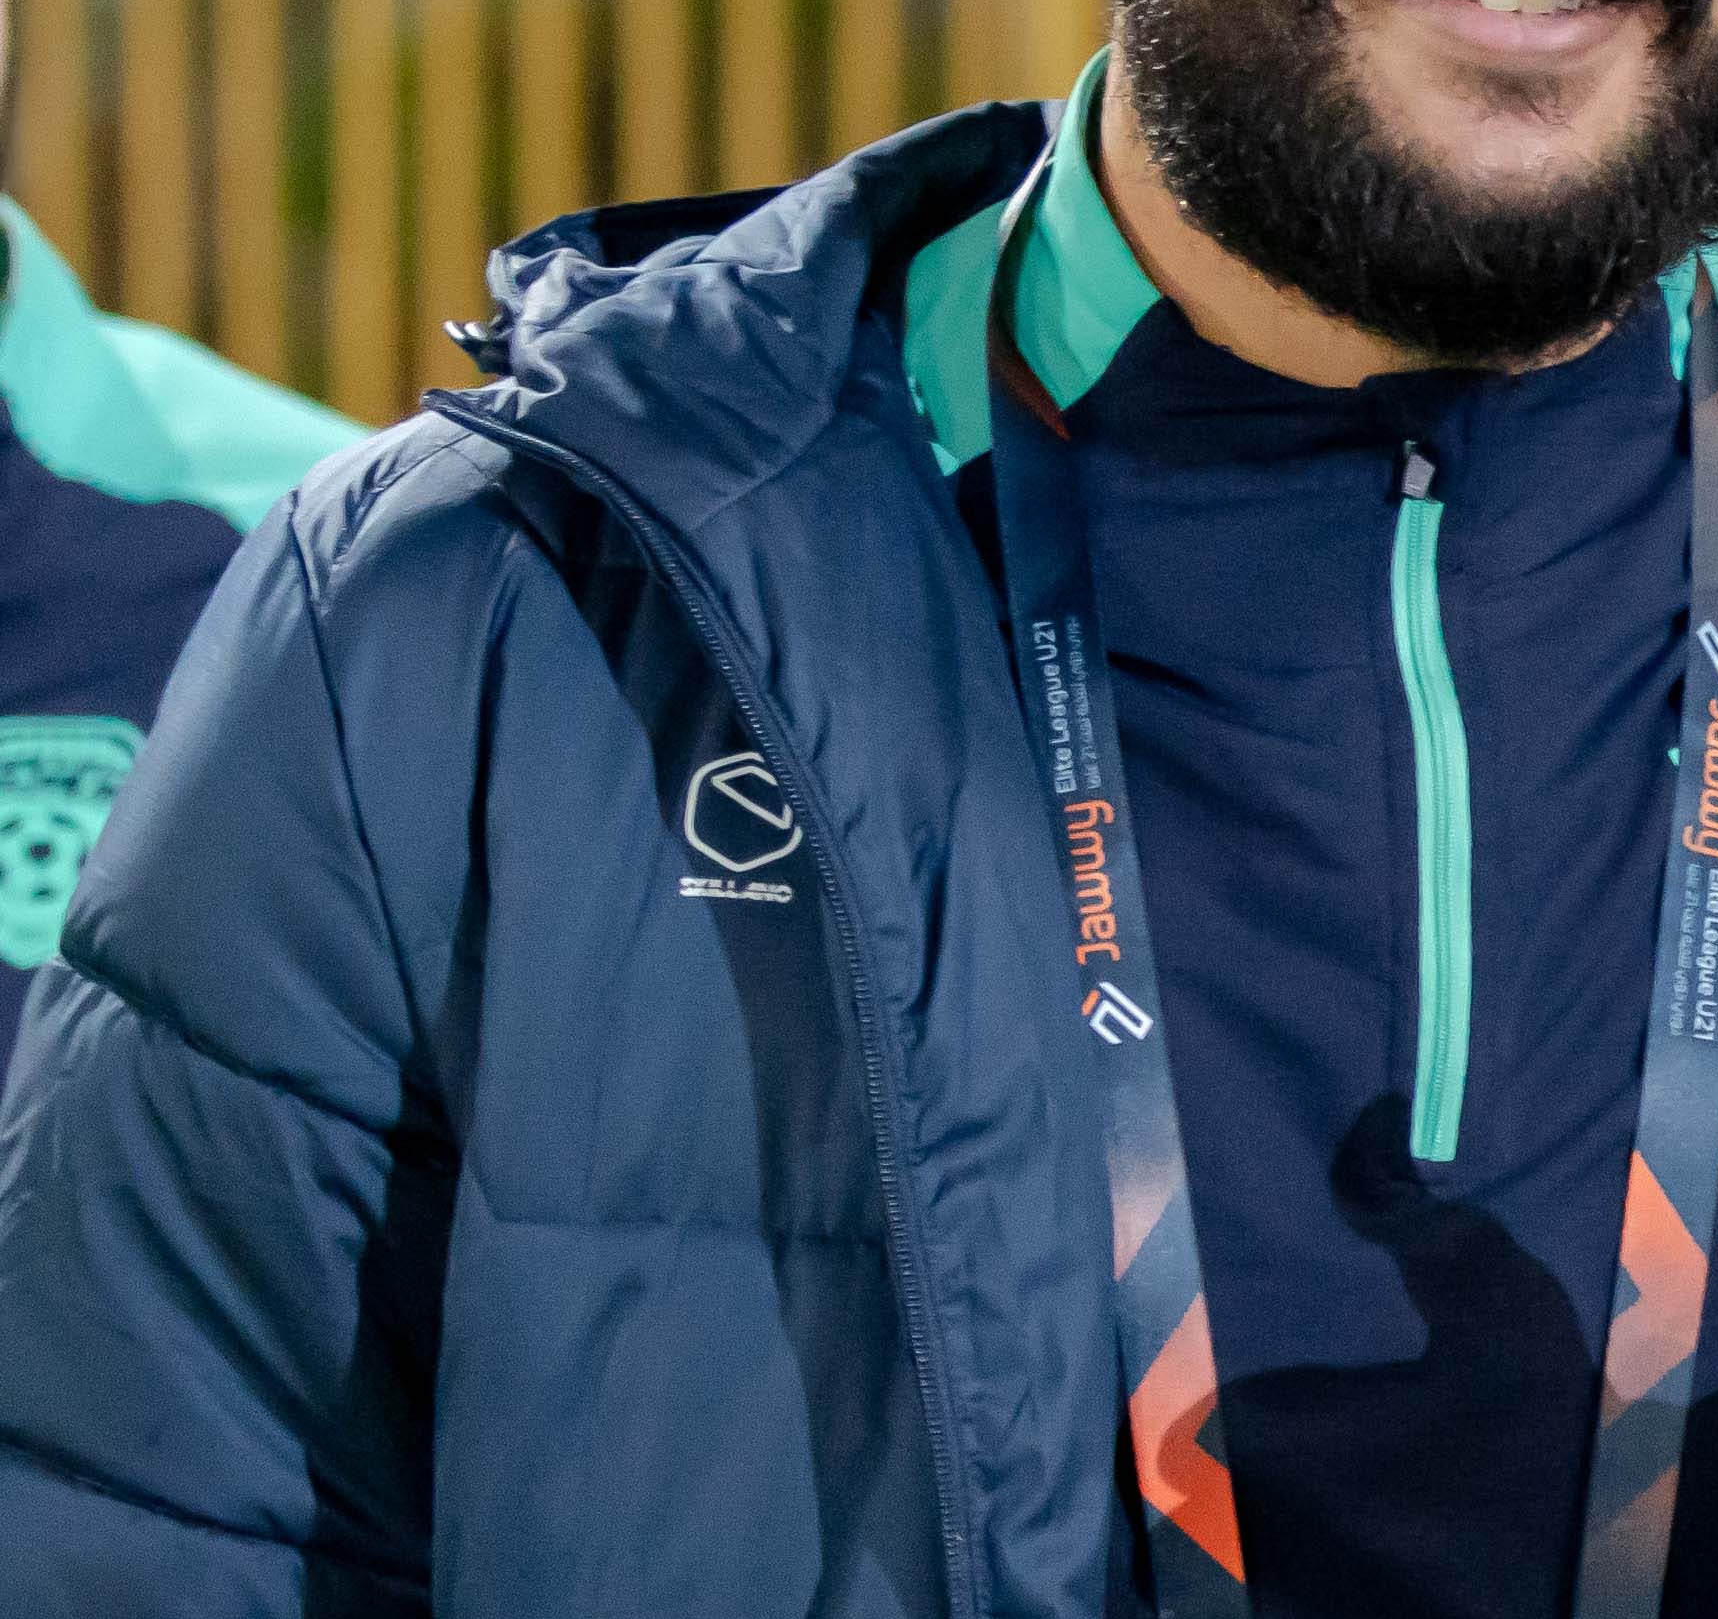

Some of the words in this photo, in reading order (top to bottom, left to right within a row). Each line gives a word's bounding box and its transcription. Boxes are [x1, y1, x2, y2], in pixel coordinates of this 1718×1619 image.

[1031, 621, 1058, 661] U21
[1043, 665, 1072, 746] League
[1054, 746, 1077, 794] Elite
[1064, 799, 1121, 967] Jawwy
[1693, 999, 1718, 1042] U21
